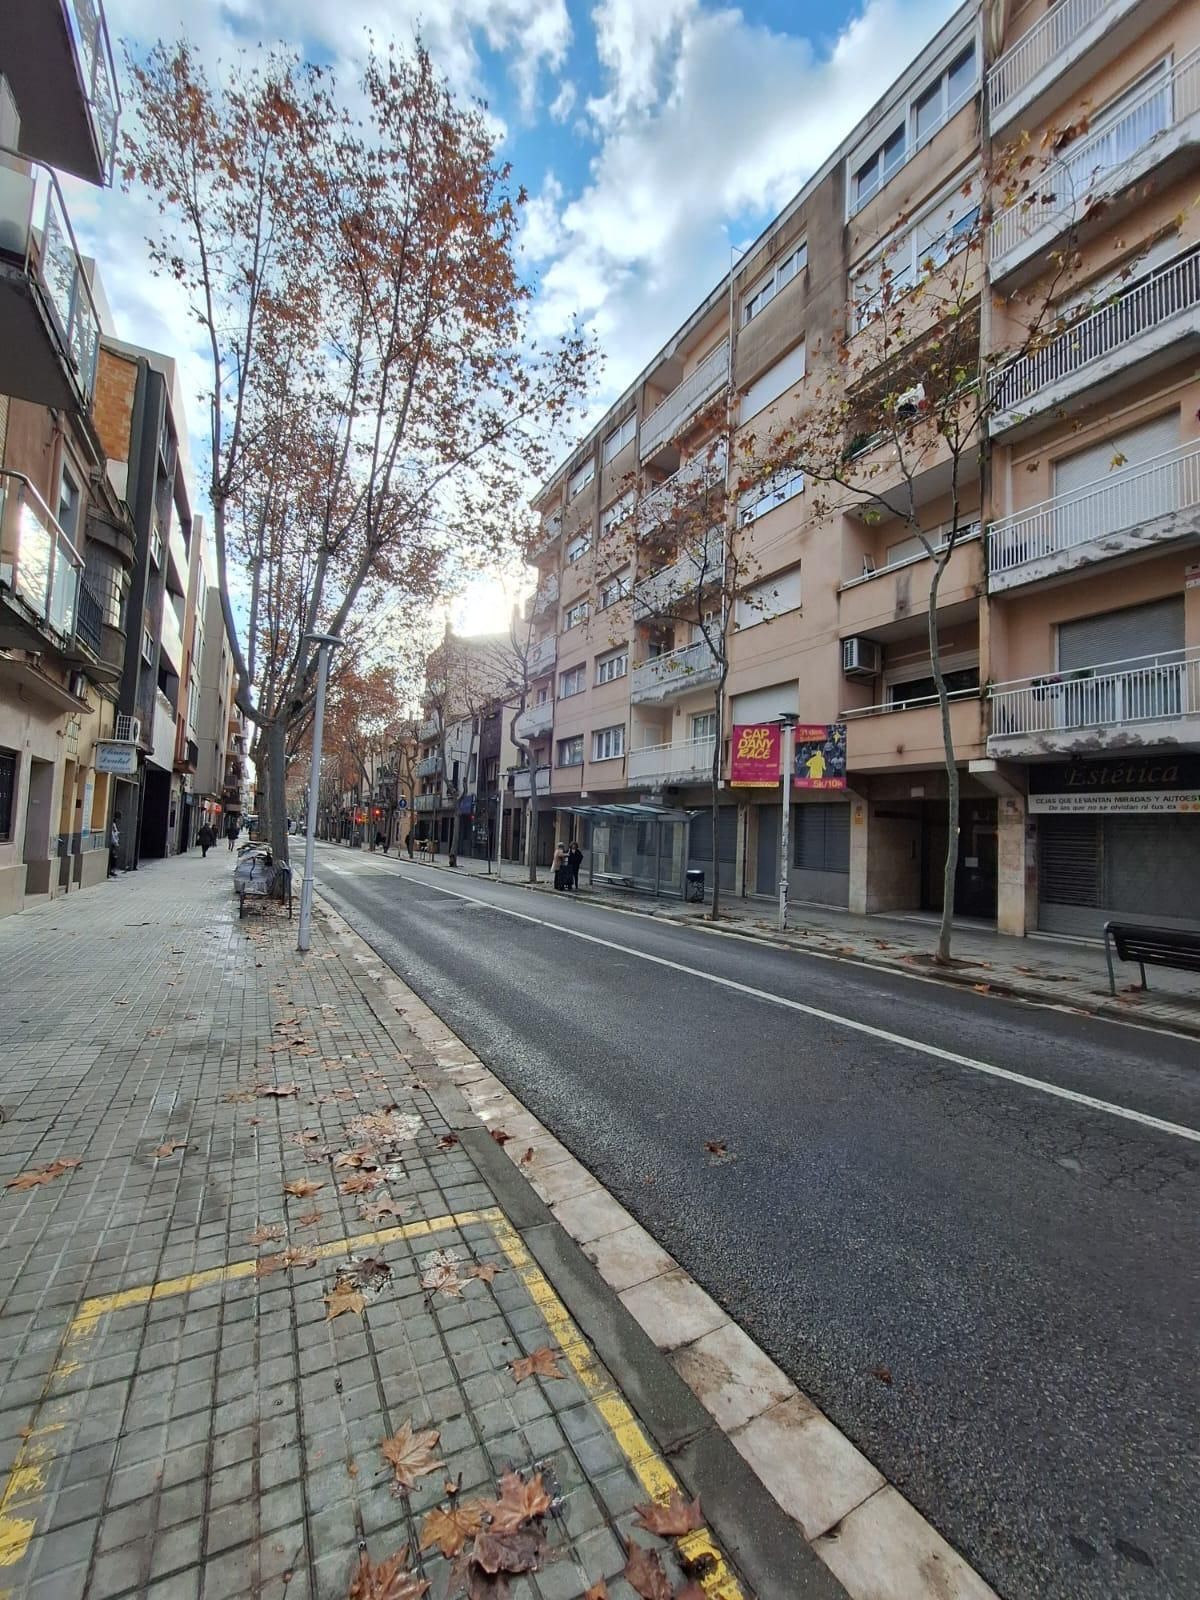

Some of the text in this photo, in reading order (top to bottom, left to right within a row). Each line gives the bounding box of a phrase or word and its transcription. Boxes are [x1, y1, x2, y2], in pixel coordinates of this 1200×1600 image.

[743, 729, 770, 739] CAP
[737, 748, 770, 759] RACE
[1064, 761, 1179, 786] Estética
